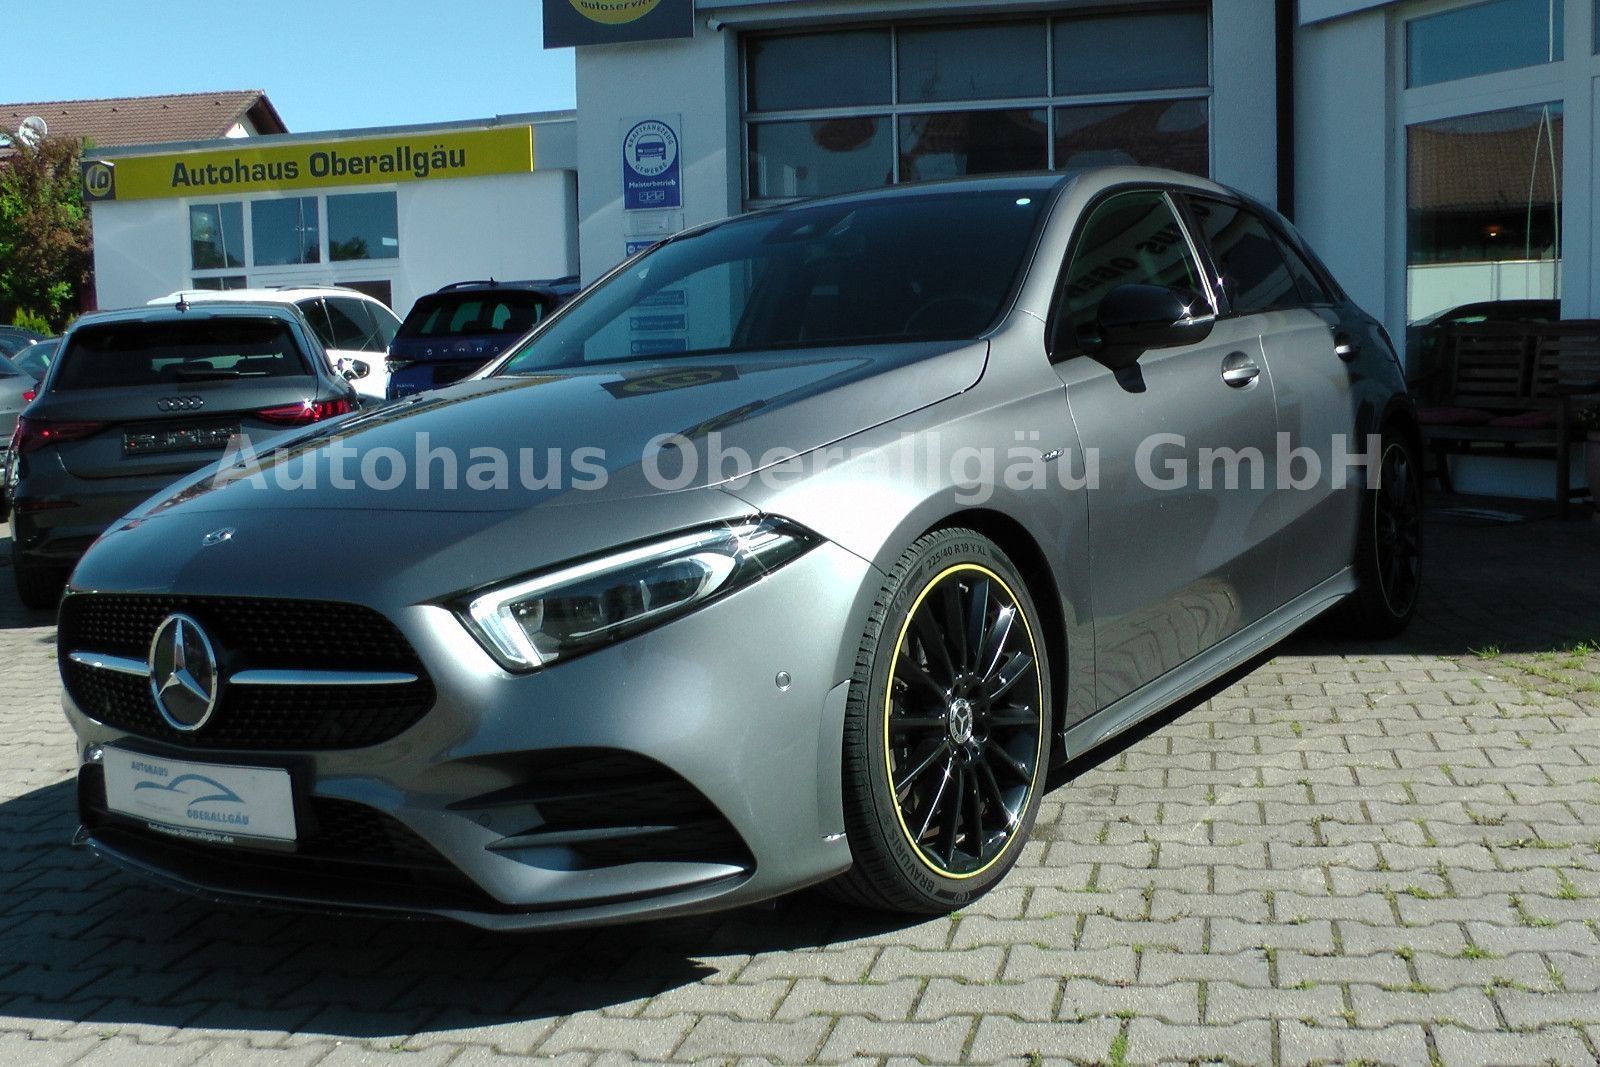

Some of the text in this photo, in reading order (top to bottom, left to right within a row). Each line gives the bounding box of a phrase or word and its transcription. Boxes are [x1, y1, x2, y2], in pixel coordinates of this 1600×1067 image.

[581, 0, 653, 11] autoservic
[171, 144, 466, 188] Autohaus Oberallgäu
[628, 179, 676, 189] Meisterbetrieb
[927, 546, 953, 570] 225/40
[131, 761, 169, 777] AUTOHAUS
[186, 808, 249, 826] OBERALLGÄU
